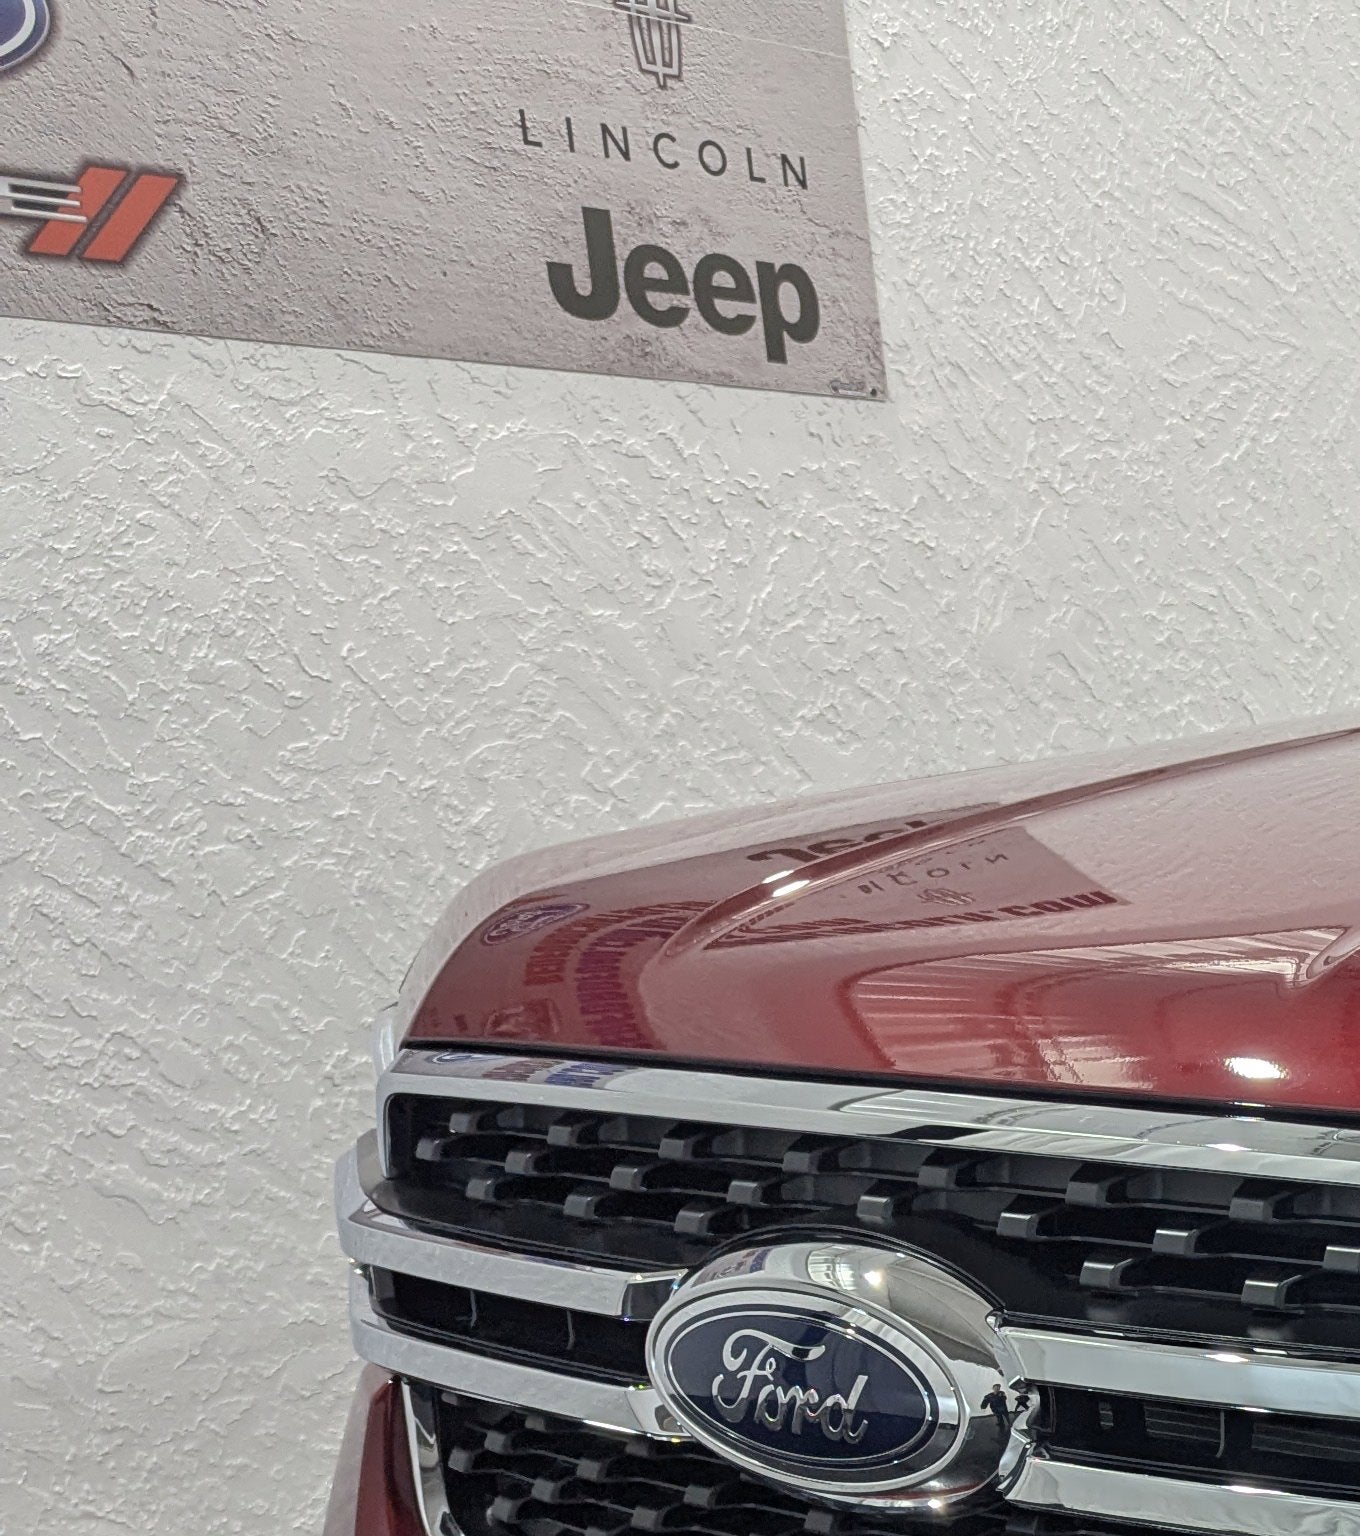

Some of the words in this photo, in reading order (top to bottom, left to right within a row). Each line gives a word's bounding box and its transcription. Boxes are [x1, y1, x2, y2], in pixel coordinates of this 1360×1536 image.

[518, 108, 808, 191] LINCOLN
[545, 205, 822, 365] Jeep
[712, 1328, 869, 1444] Ford
